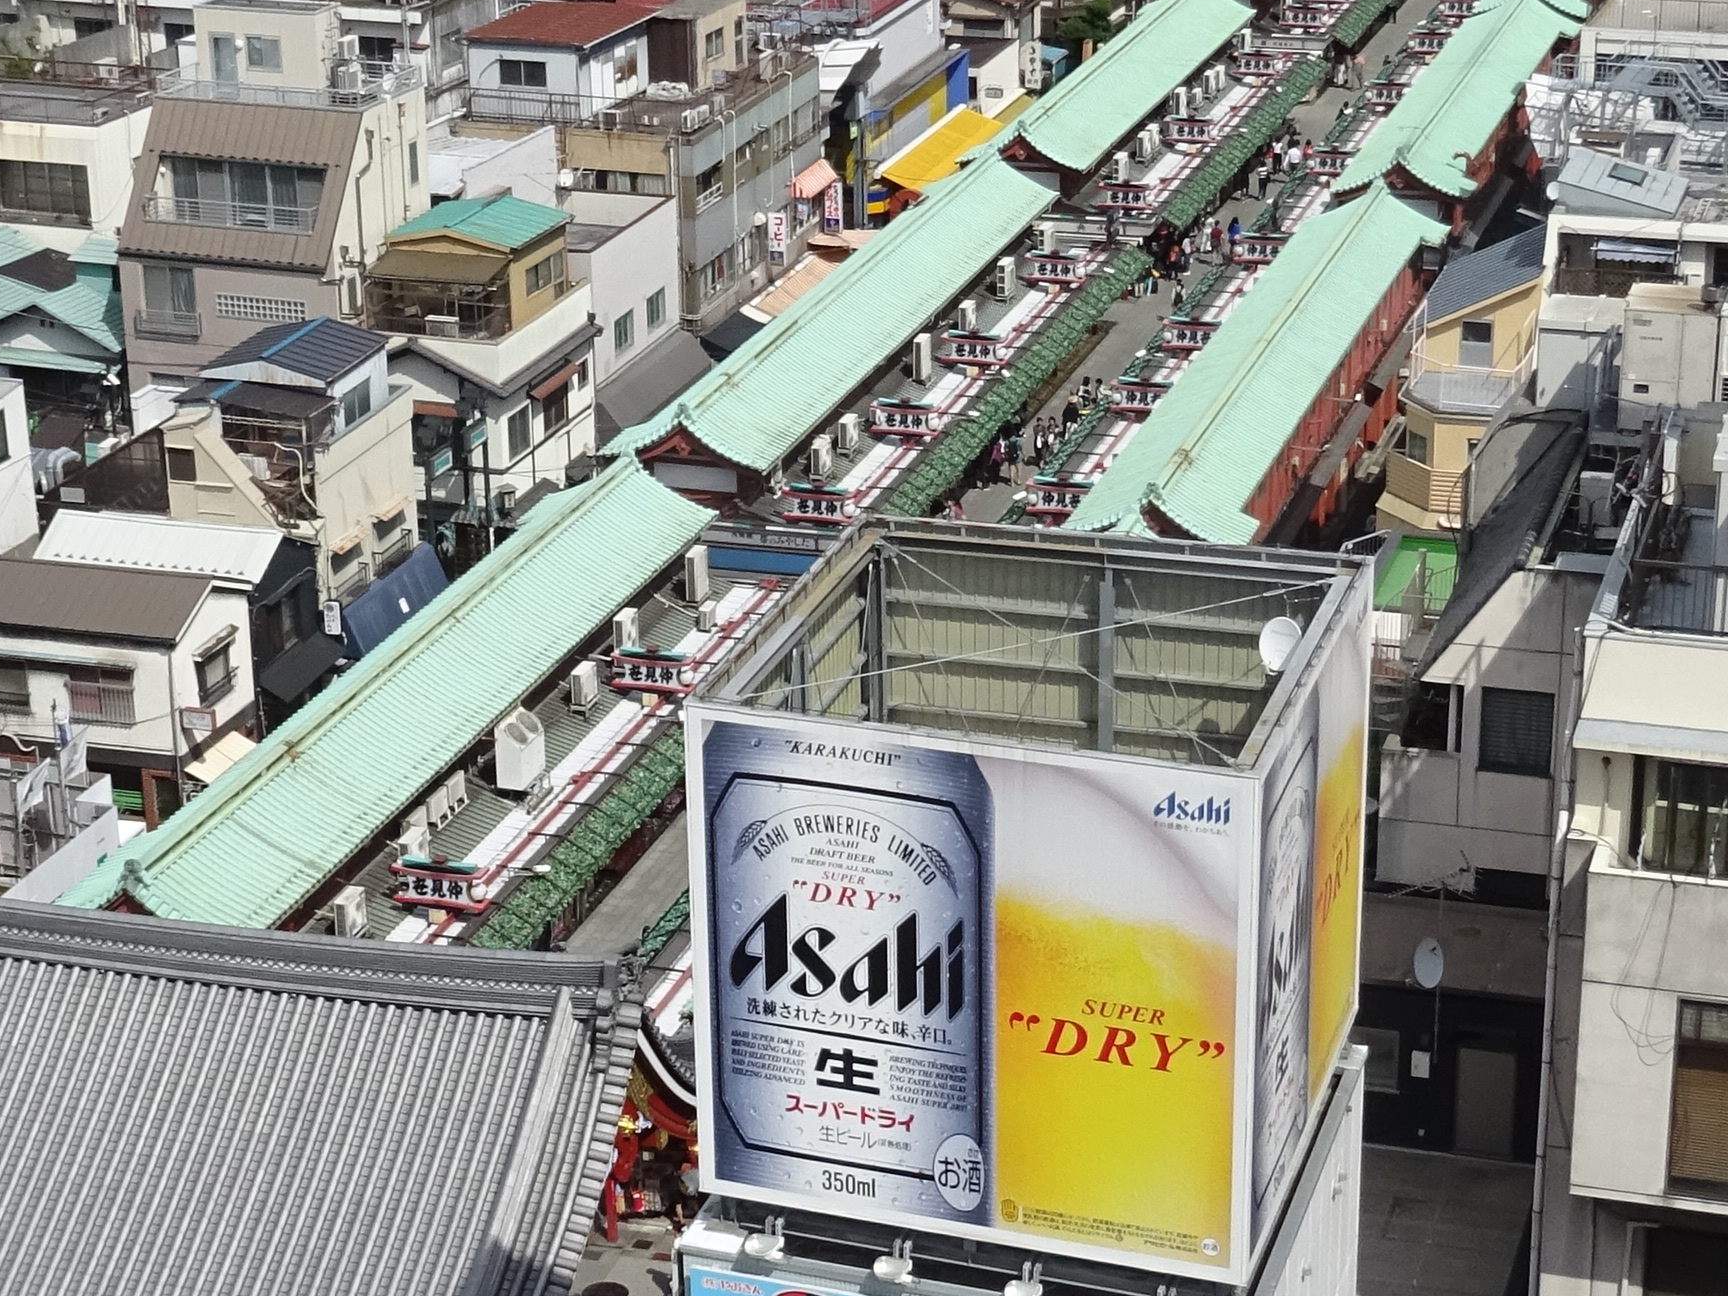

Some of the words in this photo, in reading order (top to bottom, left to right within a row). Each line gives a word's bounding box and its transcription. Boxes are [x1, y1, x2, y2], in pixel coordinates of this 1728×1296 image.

[1153, 790, 1231, 826] Asahi
[752, 823, 790, 861] ASAHI
[793, 813, 881, 844] BREWERIES
[886, 834, 938, 887] LIMITED
[808, 846, 845, 861] DRAFT
[845, 851, 876, 865] BEER
[825, 837, 860, 850] ASAHI
[821, 870, 866, 886] SUPER
[844, 864, 860, 872] ALL
[729, 892, 966, 1021] Asahi
[747, 996, 954, 1046] 洗練されたクリアな味、辛口。
[1080, 998, 1166, 1026] SUPER
[746, 1060, 806, 1076] INGREDIENTS
[763, 1071, 806, 1086] ADVANCED
[814, 1047, 881, 1096] 生
[889, 1084, 955, 1100] SMOOTHNESS
[785, 1094, 915, 1133] スーパードライ
[818, 1125, 878, 1149] 生ビール
[821, 1170, 877, 1198] 350ml
[937, 1156, 982, 1195] お酒
